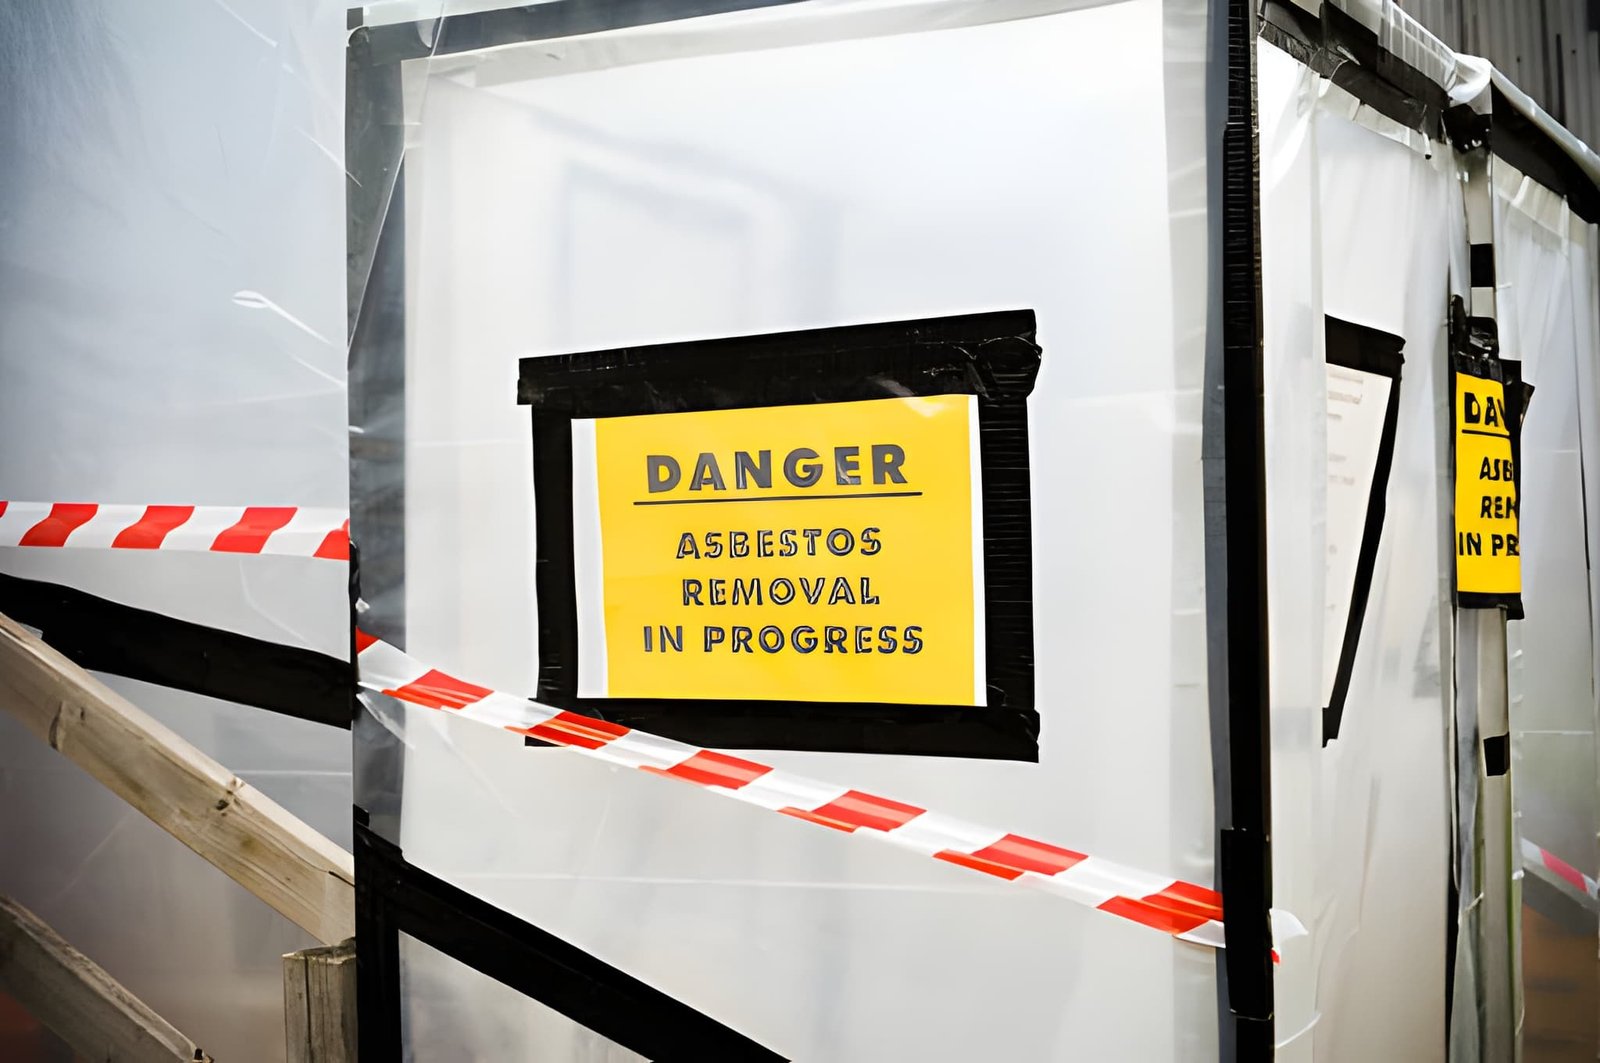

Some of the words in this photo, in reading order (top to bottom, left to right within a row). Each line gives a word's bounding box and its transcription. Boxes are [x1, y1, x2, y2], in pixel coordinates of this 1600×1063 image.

[646, 444, 908, 493] DANGER
[676, 527, 882, 560] ASBESTOS
[1459, 532, 1481, 555] IN
[683, 576, 880, 606] REMOVAL
[643, 625, 683, 653] IN
[703, 625, 924, 655] PROGRESS
